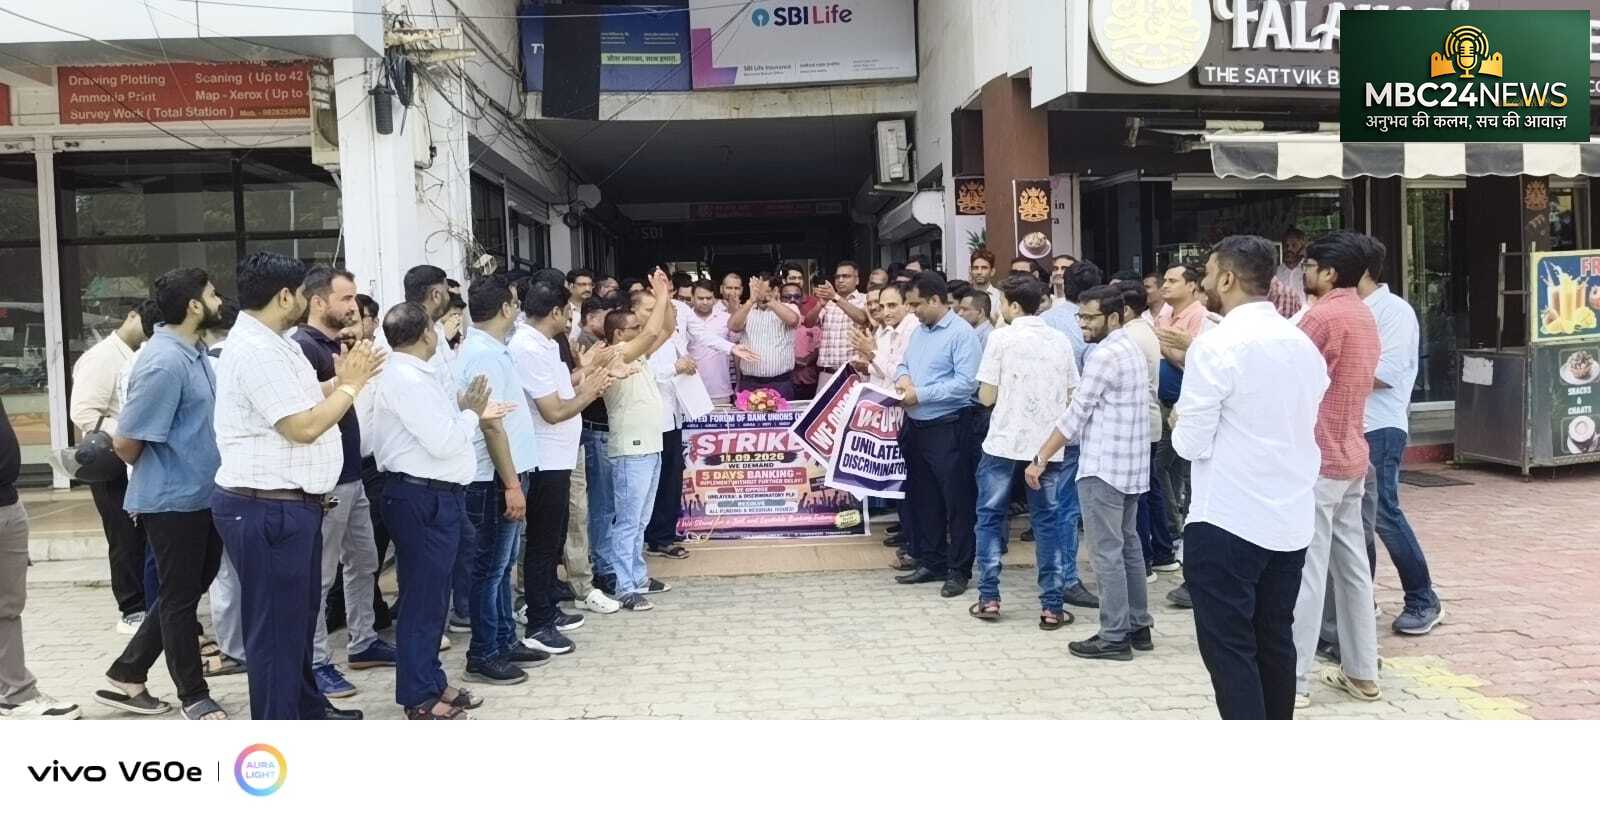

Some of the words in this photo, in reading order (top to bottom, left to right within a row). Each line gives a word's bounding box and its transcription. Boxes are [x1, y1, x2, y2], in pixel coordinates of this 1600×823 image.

[774, 6, 809, 26] SBI
[813, 5, 852, 25] Life
[69, 75, 117, 87] Drawing
[121, 74, 166, 86] Plotting
[195, 73, 242, 84] Scaning
[255, 72, 272, 84] Up
[275, 72, 286, 82] to
[289, 71, 303, 81] 42
[1205, 66, 1239, 83] THE
[1245, 67, 1322, 84] SATTVIK
[128, 91, 157, 102] Print
[195, 91, 220, 102] Map
[230, 90, 262, 100] Xerox
[273, 89, 288, 99] Up
[292, 89, 303, 98] to
[70, 109, 110, 121] Survey
[113, 106, 144, 119] Work
[153, 107, 183, 118] Total
[186, 106, 227, 117] Station
[710, 413, 735, 422] FORUM
[737, 413, 746, 421] OF
[747, 412, 767, 421] BANK
[768, 412, 794, 421] UNIONS
[719, 453, 785, 463] 11.09.2026
[702, 471, 710, 480] 5
[714, 470, 745, 480] DAYS
[747, 469, 794, 479] BANKING
